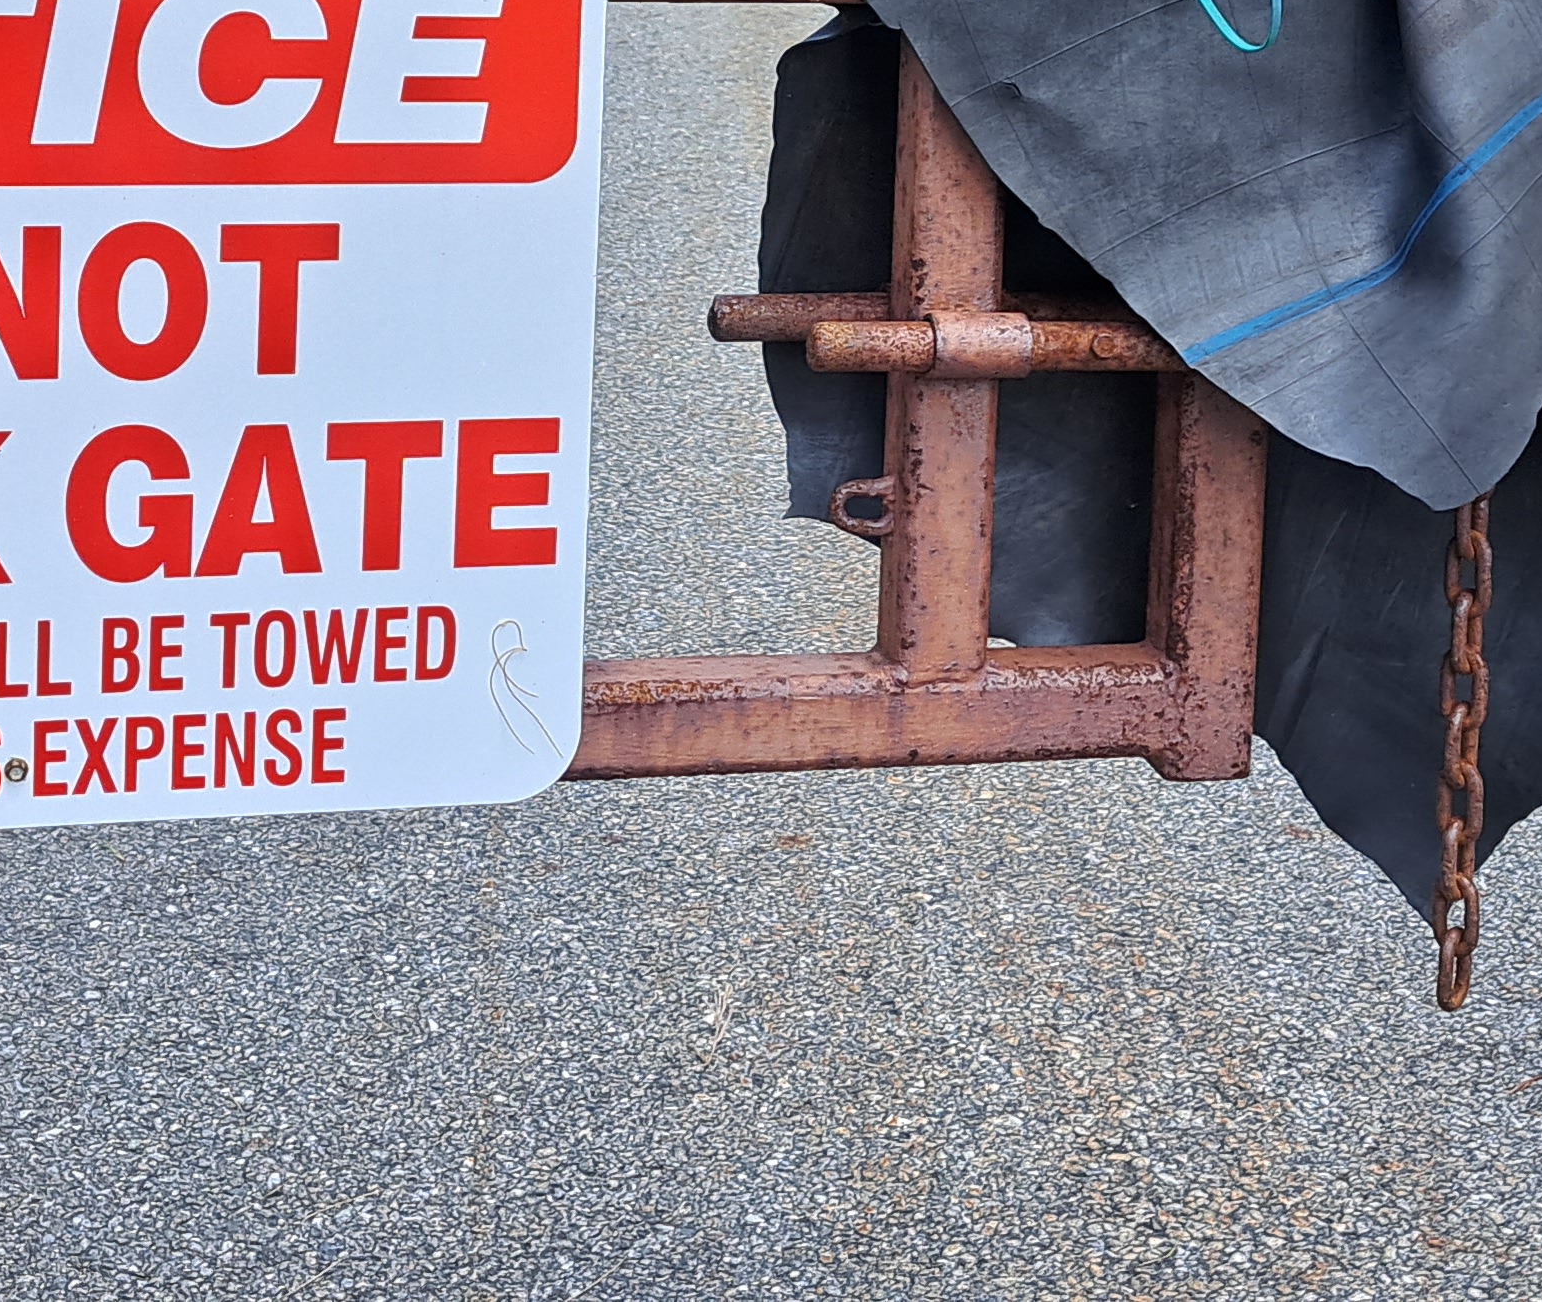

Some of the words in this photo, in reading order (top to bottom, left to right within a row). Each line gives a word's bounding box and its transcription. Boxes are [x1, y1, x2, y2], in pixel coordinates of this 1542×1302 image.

[66, 417, 561, 584] GATE
[102, 615, 185, 694] BE
[211, 606, 456, 689] TOWED
[33, 708, 347, 797] EXPENSE
